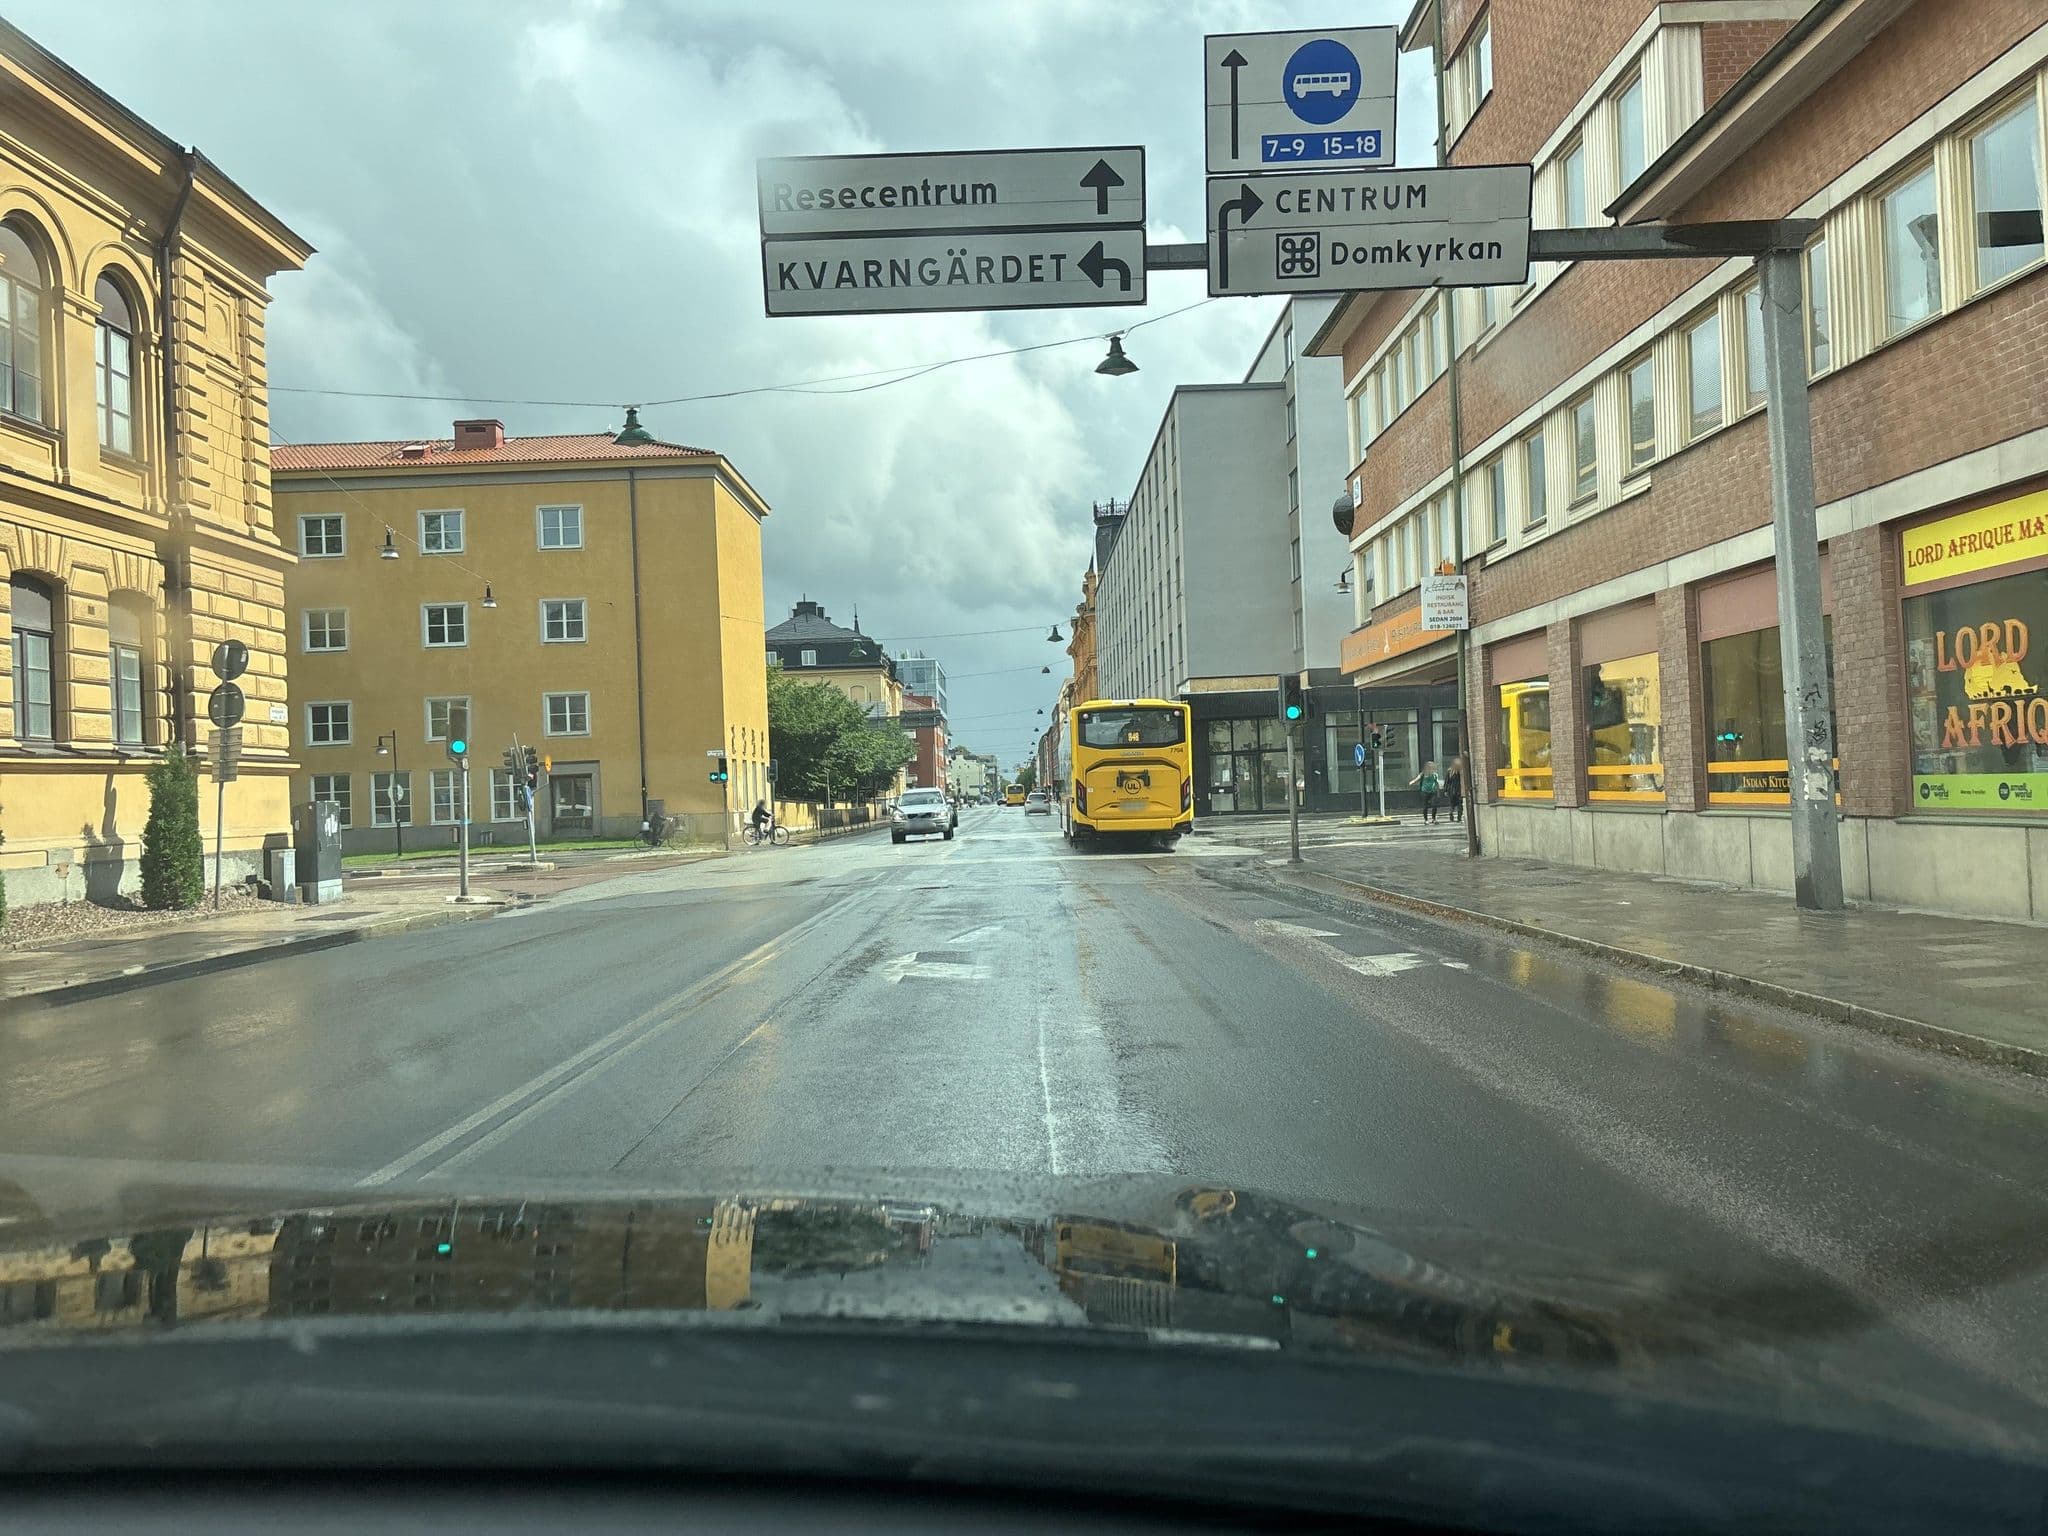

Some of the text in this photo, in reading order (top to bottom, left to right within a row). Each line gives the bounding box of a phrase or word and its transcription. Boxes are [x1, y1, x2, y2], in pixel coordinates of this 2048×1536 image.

[1266, 135, 1377, 157] 7-9 15-18
[773, 178, 997, 213] Resecentrum
[1275, 184, 1427, 214] CENTRUM
[778, 248, 1067, 291] KVARNGÄRDET
[1331, 238, 1503, 268] Domkyrkan
[1908, 543, 1944, 568] LORD
[1948, 523, 2016, 558] AFRIQUE
[1936, 618, 2029, 672] LORD
[1941, 697, 2048, 749] AFRIQ
